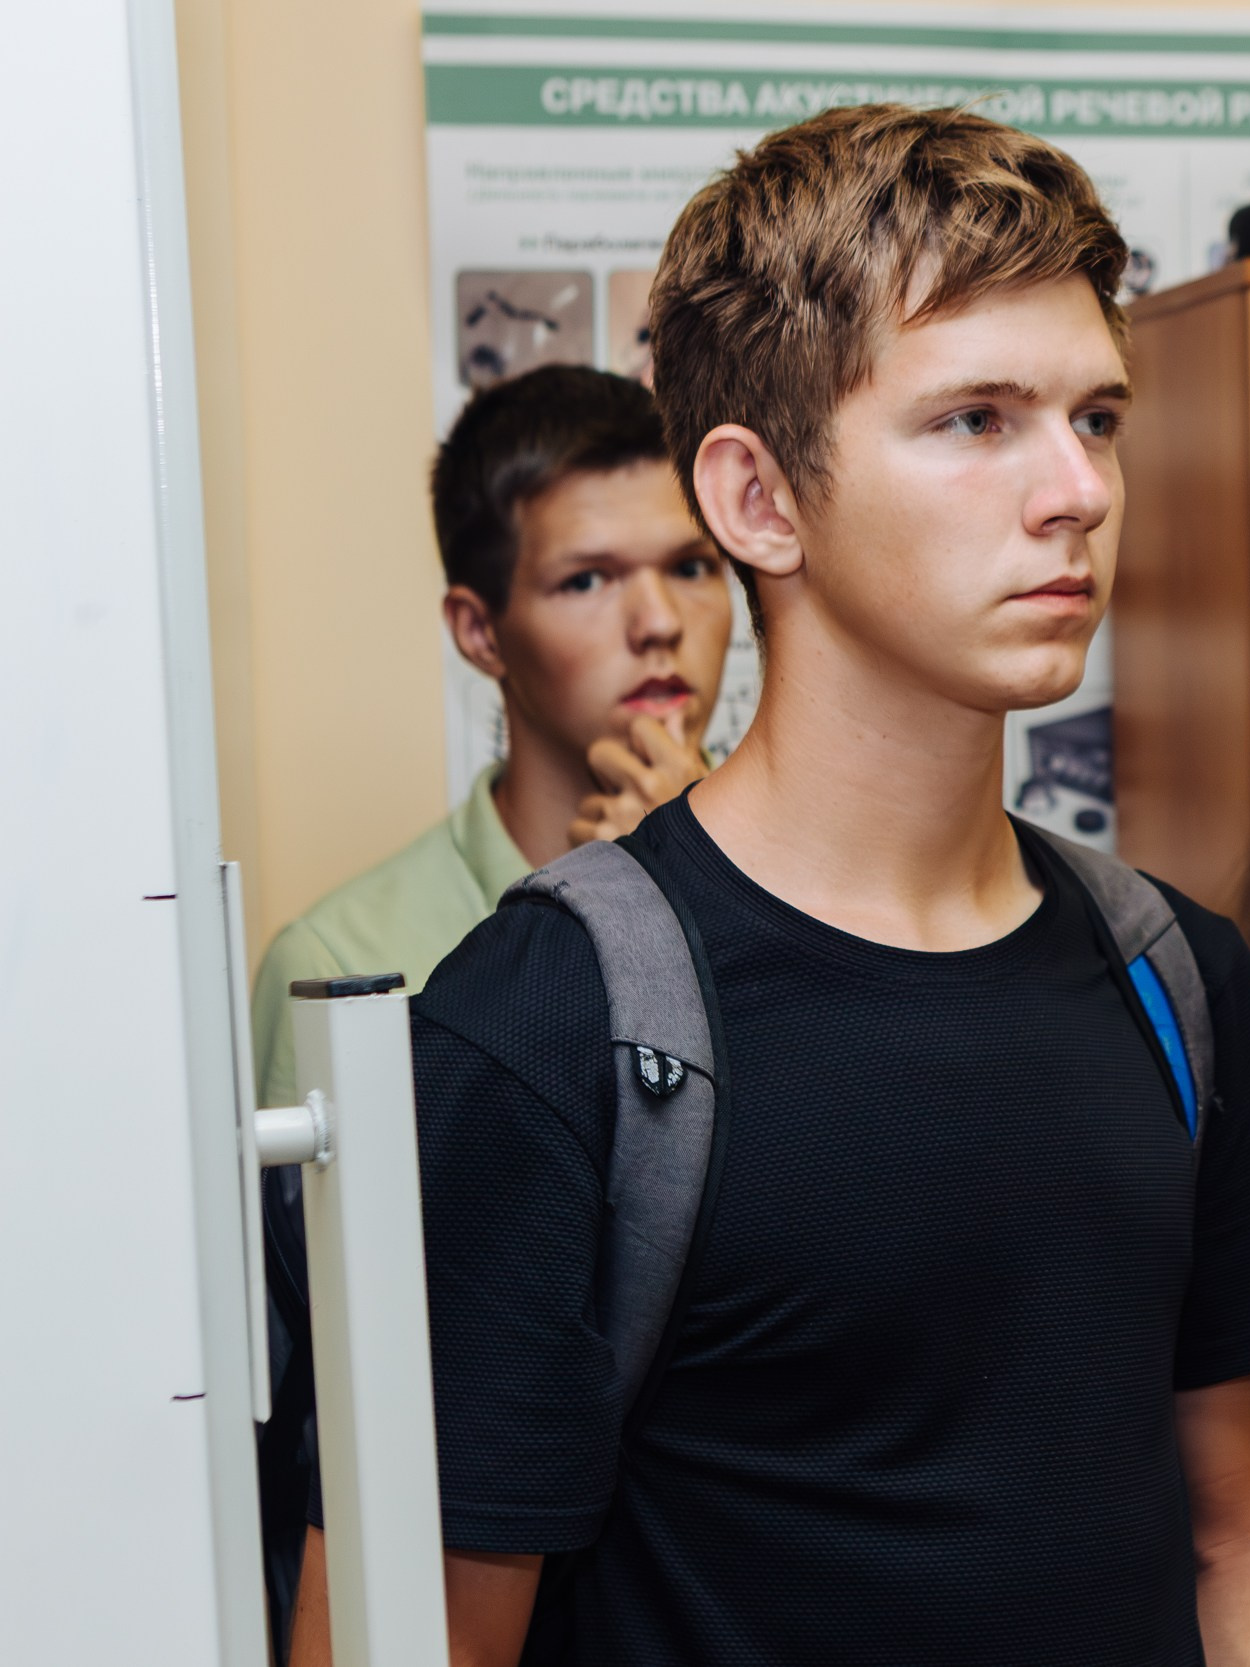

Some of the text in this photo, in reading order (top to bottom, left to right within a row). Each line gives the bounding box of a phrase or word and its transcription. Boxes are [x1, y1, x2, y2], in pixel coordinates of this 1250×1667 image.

[540, 76, 749, 122] СРЕДСТВА
[754, 79, 1044, 123] АКУСТИЧЕСКОЙ
[1050, 86, 1221, 127] РЕЧЕВОЙ
